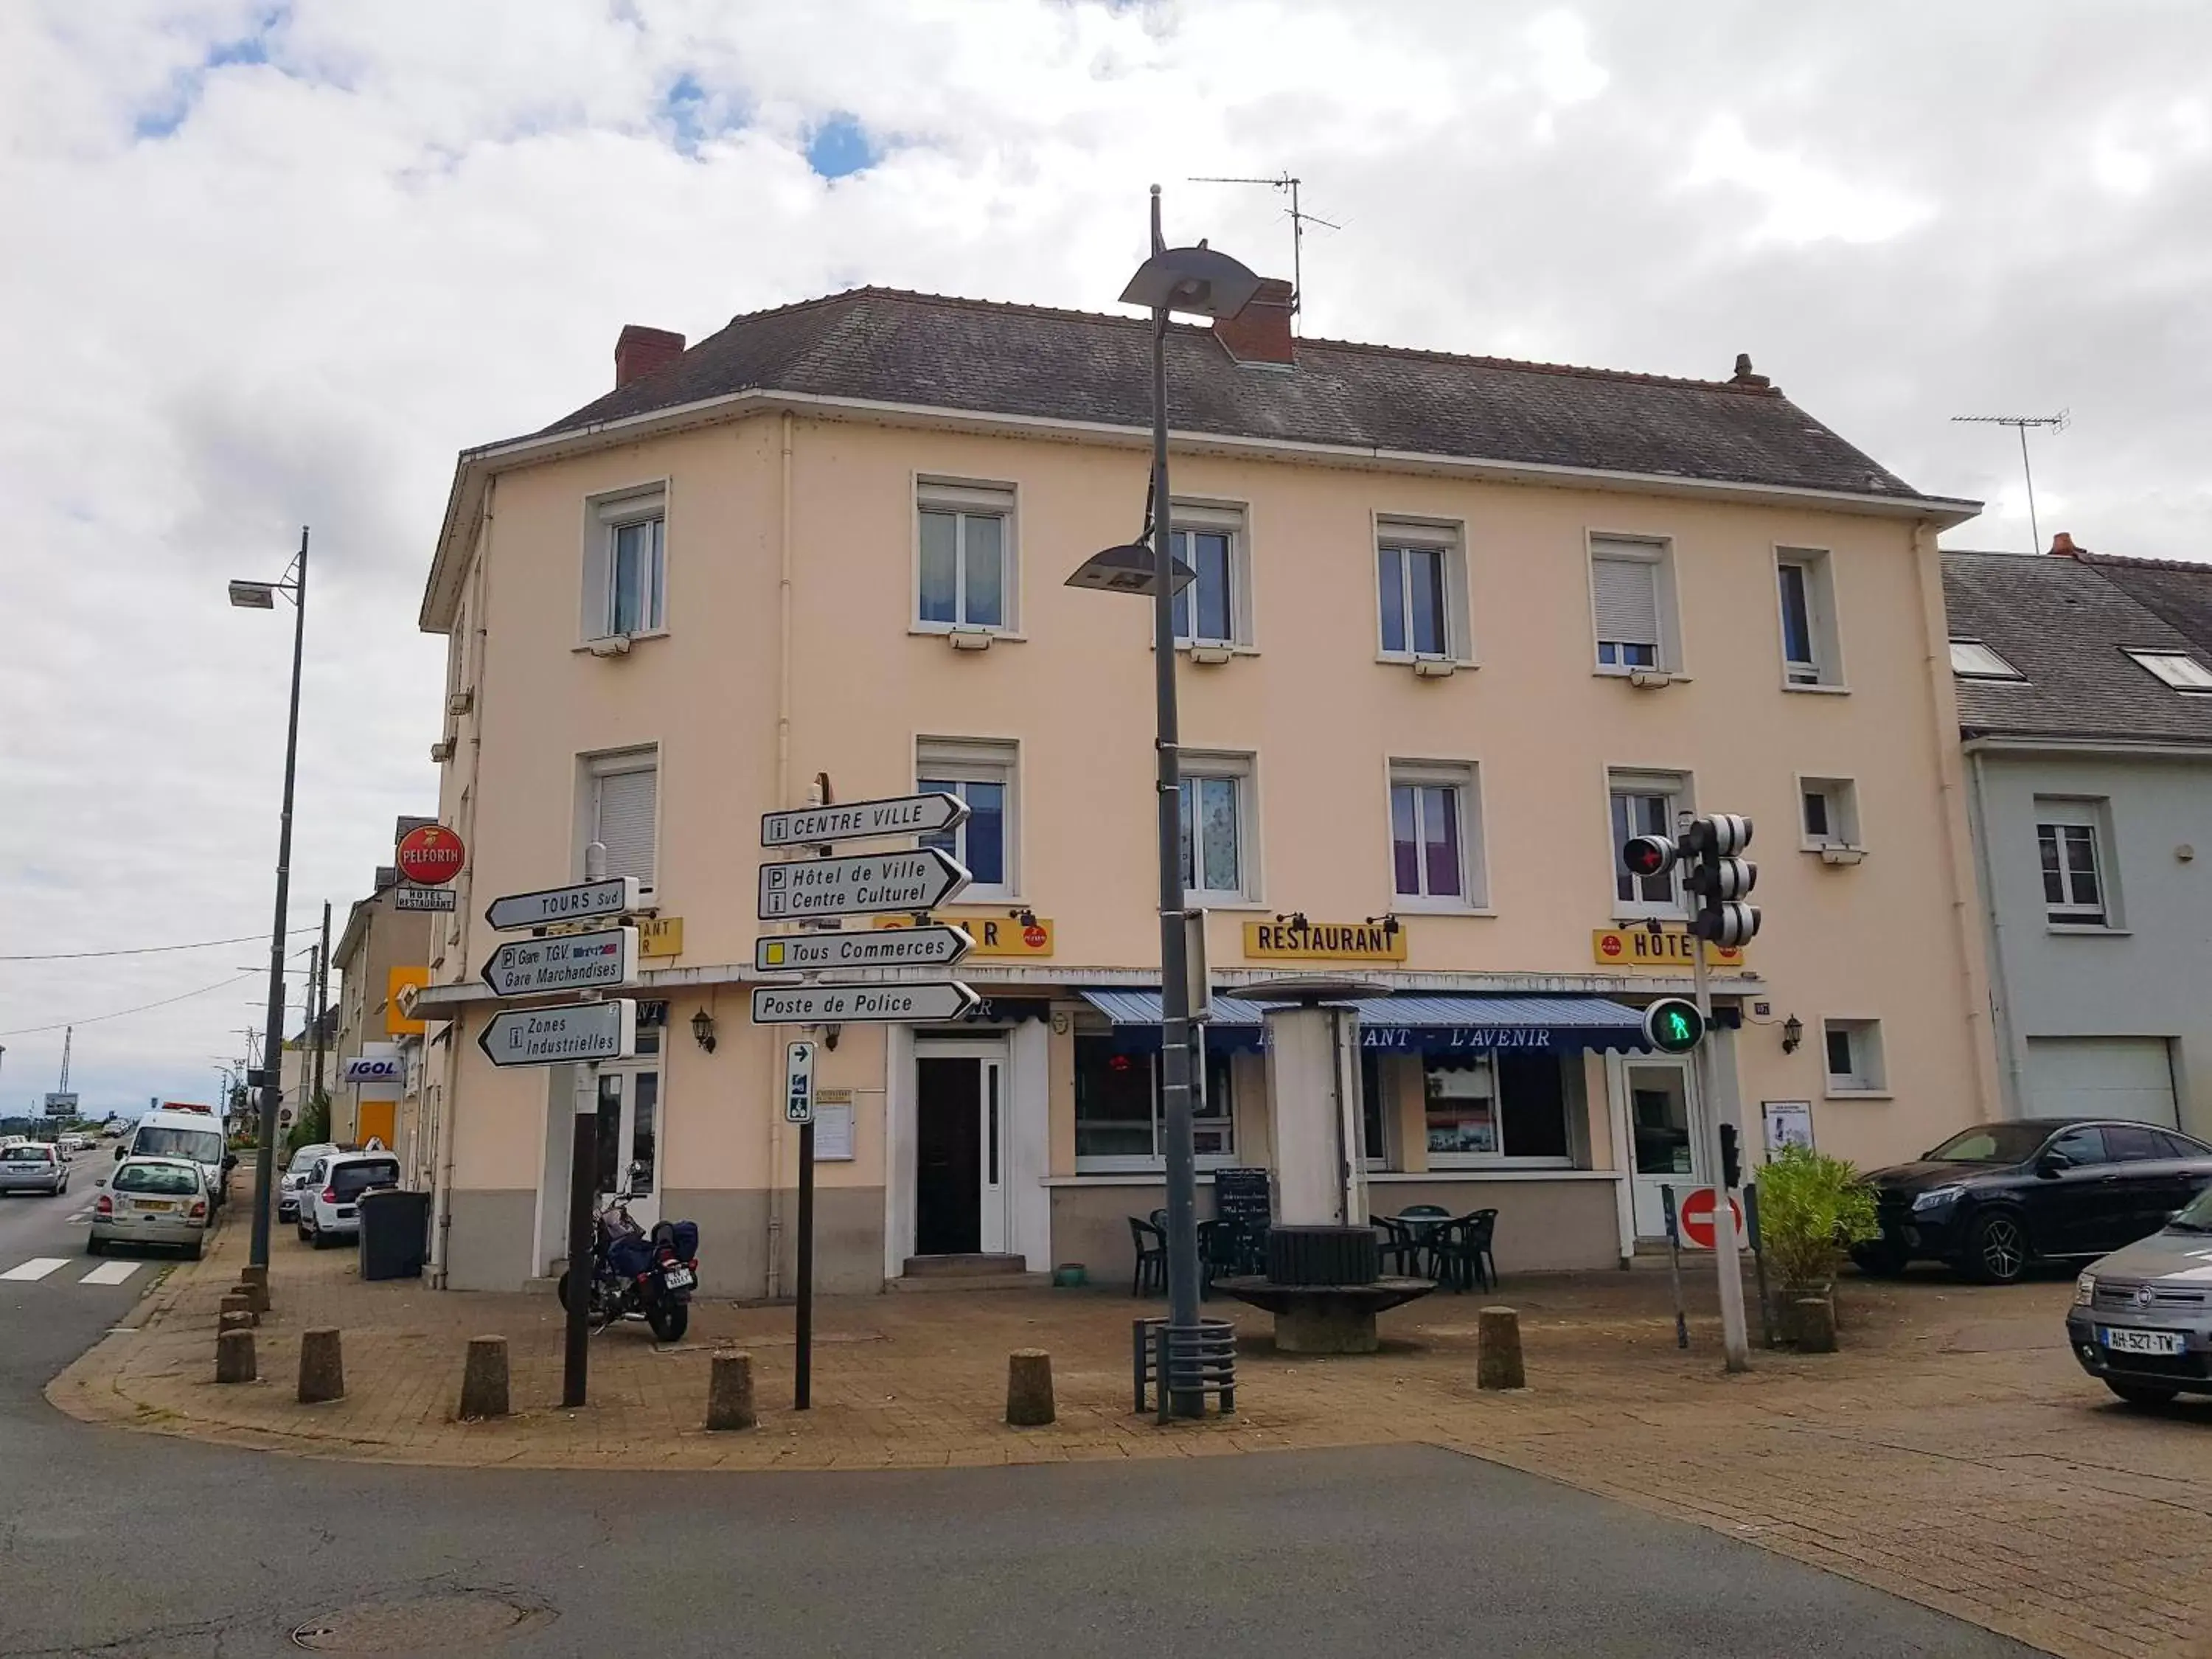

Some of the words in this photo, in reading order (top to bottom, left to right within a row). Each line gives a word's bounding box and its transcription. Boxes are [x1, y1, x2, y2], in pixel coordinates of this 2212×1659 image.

[794, 812, 862, 835] CENTRE
[874, 805, 922, 827] VILLE
[403, 849, 458, 864] PELFORTH
[772, 871, 783, 887] P
[793, 867, 841, 886] Hôtel
[852, 866, 872, 882] de
[883, 860, 925, 879] Ville
[399, 898, 452, 909] RESTAURANT
[409, 891, 442, 900] HOTEL
[542, 892, 589, 914] TOURS
[597, 890, 619, 906] Sud
[793, 891, 846, 908] Centre
[857, 883, 926, 904] Culturel
[1259, 925, 1394, 953] RESTAURANT
[1635, 933, 1693, 957] HOTE
[518, 950, 540, 965] Gare
[792, 944, 830, 961] Tous
[841, 941, 945, 959] Commerces
[505, 971, 530, 987] Gare
[537, 961, 616, 984] Marchandises
[764, 997, 813, 1015] Poste
[824, 995, 845, 1012] de
[855, 993, 913, 1012] Police
[528, 1018, 566, 1033] Zones
[526, 1036, 614, 1055] Industrielles
[1451, 1029, 1551, 1046] L'AVENIR
[349, 1062, 394, 1075] IGOL
